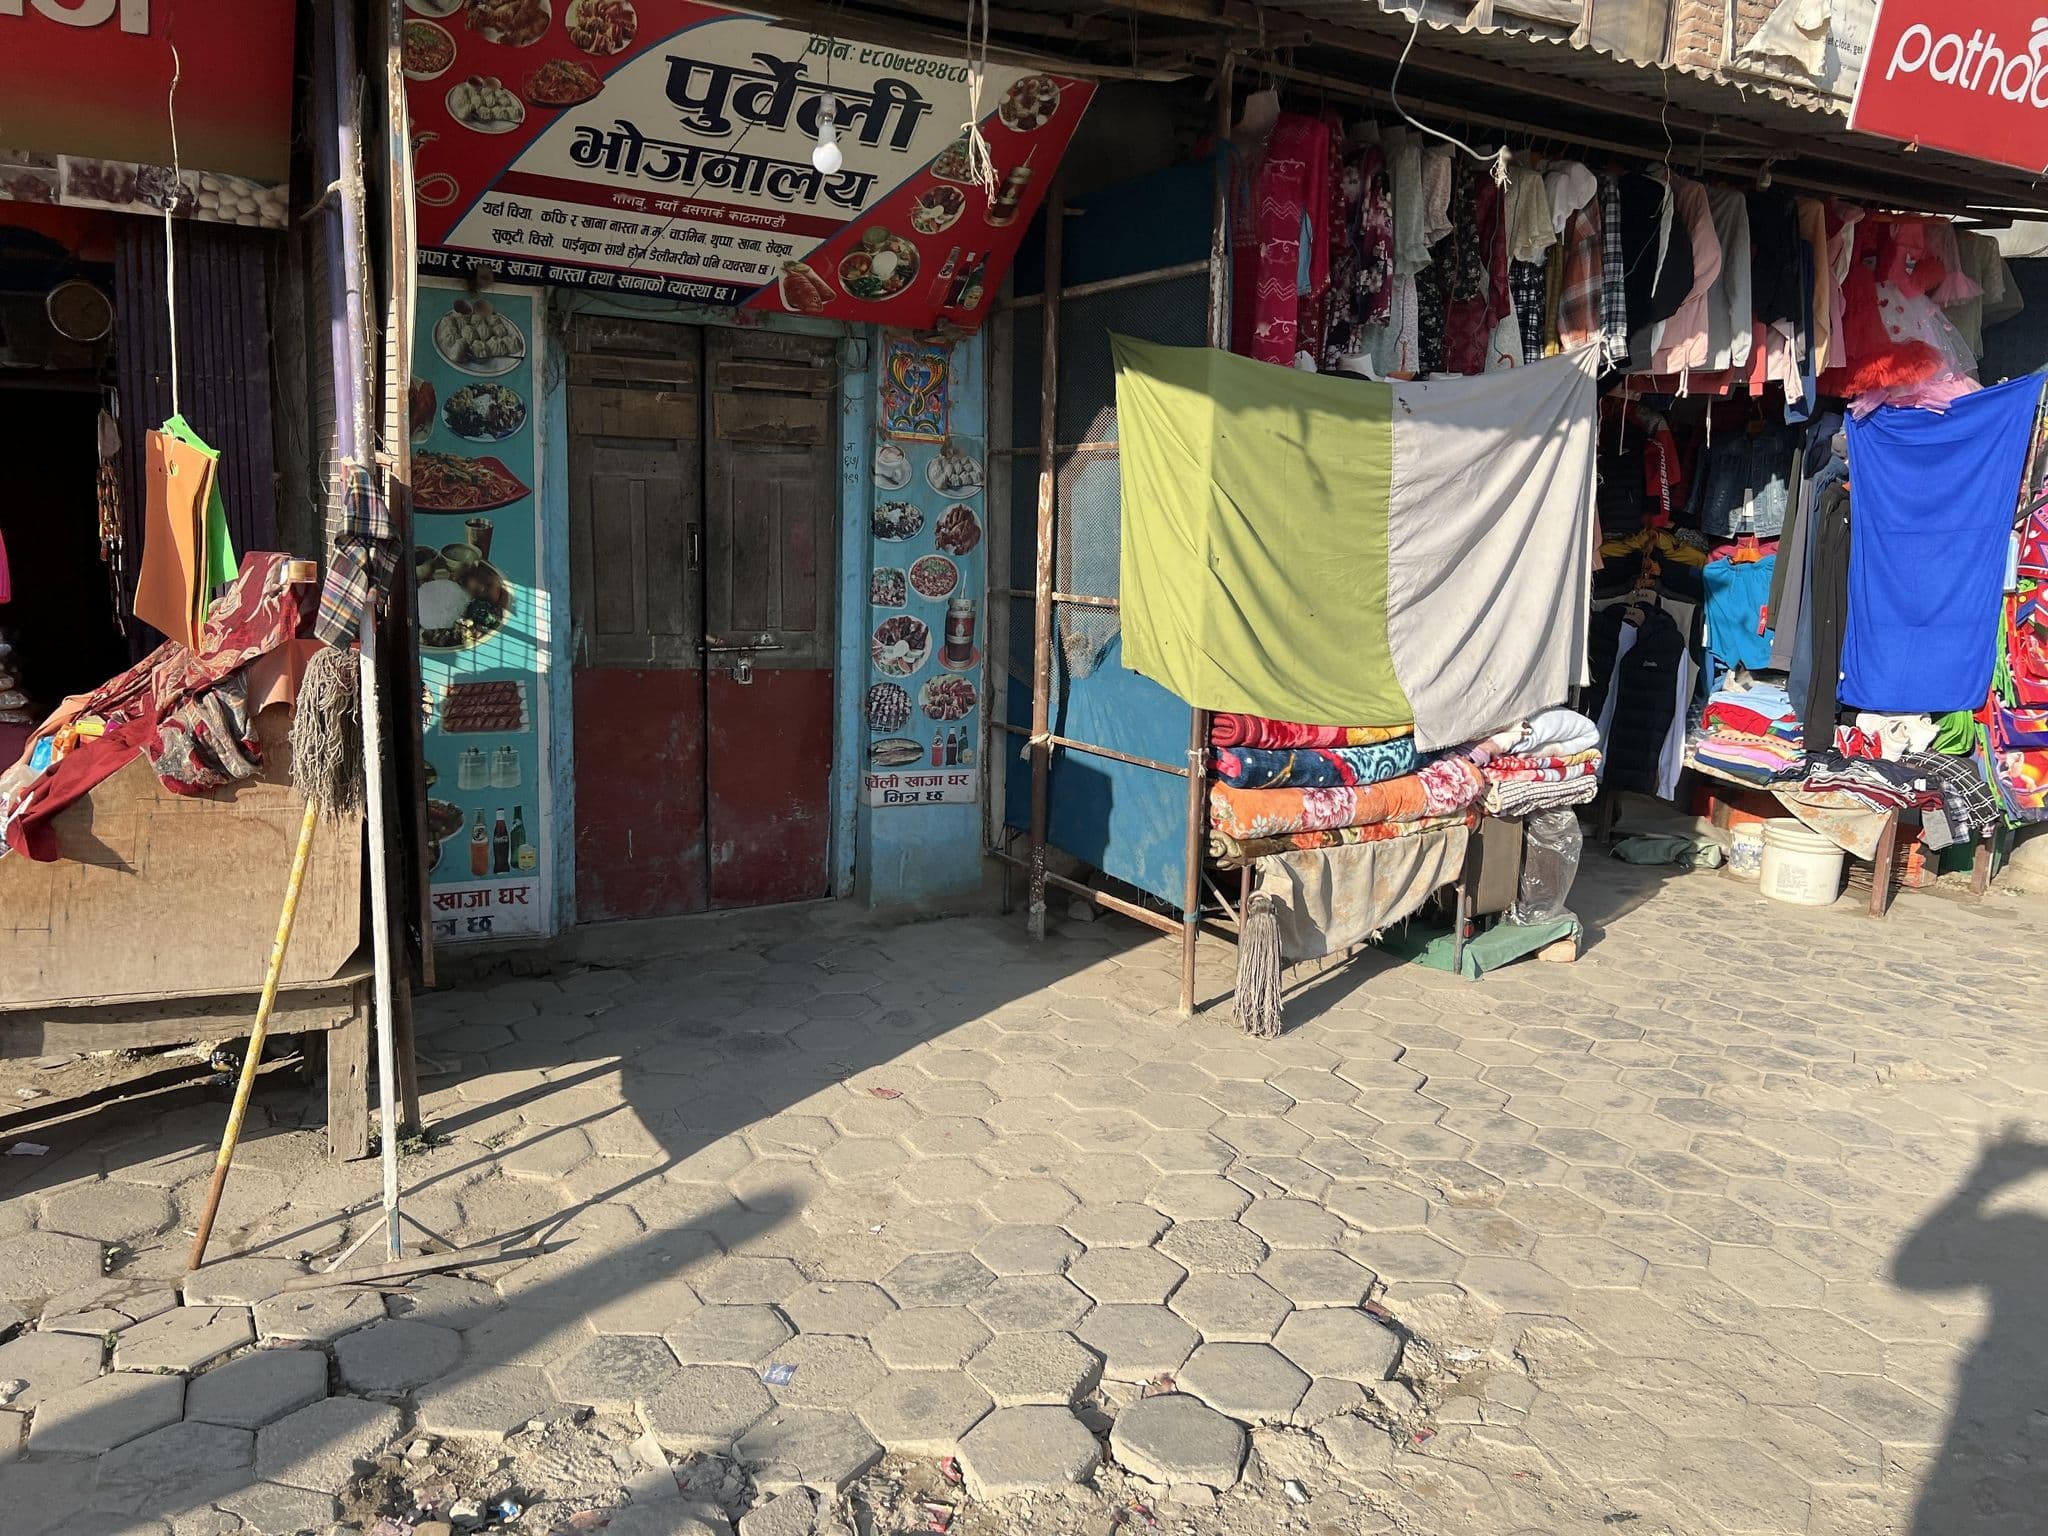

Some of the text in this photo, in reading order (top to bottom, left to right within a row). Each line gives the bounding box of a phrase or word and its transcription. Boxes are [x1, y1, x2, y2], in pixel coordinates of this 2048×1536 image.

[568, 120, 878, 210] भोजनालय
[570, 214, 580, 227] र
[581, 215, 609, 231] खाना
[610, 219, 639, 235] नास्ता
[452, 253, 463, 269] र
[548, 264, 587, 283] नास्ता
[588, 269, 615, 286] तथा
[617, 275, 666, 293] खानाको
[667, 280, 712, 298] व्यवस्था
[714, 286, 729, 301] छ
[722, 260, 757, 275] व्यवस्था
[757, 264, 770, 276] छ
[905, 776, 944, 788] खाजा
[947, 775, 970, 786] घर
[433, 886, 531, 911] खाजा घर
[467, 915, 495, 933] छ
